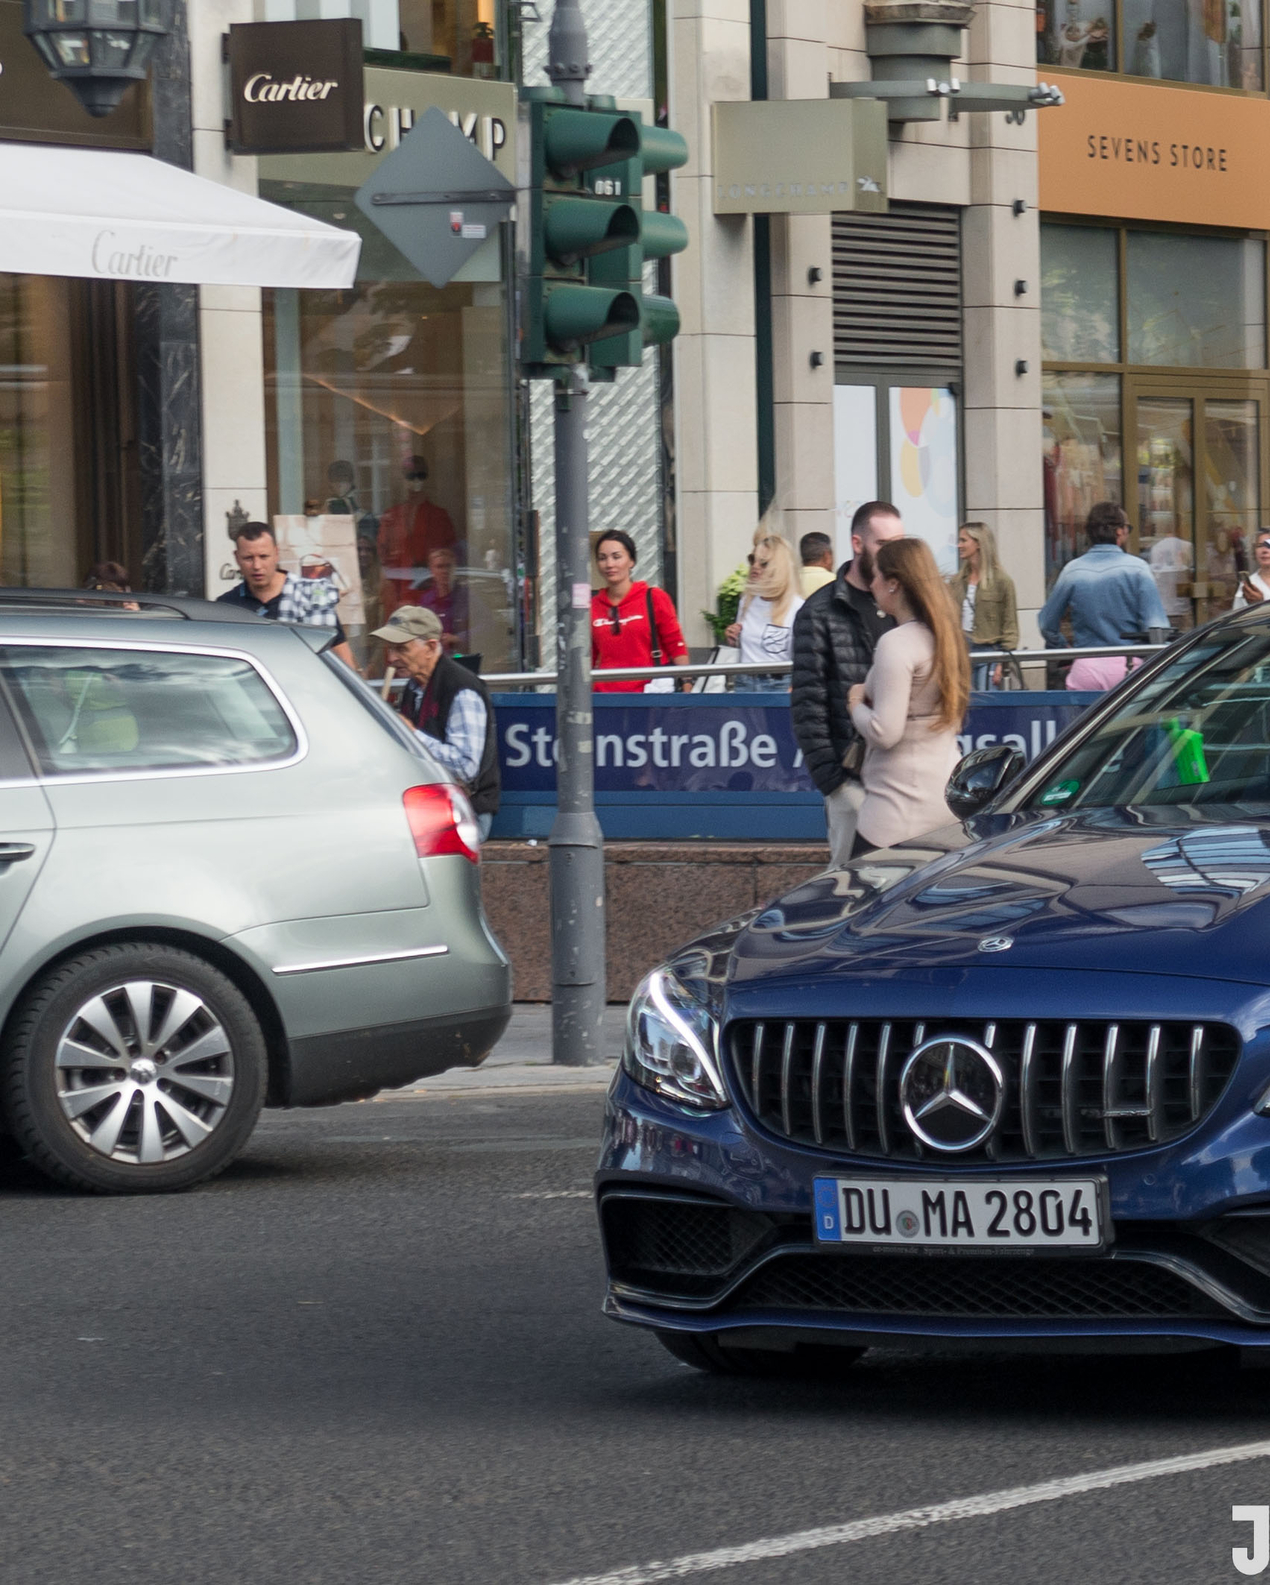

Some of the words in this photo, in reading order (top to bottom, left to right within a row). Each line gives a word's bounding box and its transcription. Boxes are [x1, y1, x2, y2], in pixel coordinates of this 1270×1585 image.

[244, 73, 339, 103] Cartier
[363, 103, 506, 162] CHMP
[1087, 134, 1161, 166] SEVENS
[1169, 142, 1228, 173] STORE
[717, 181, 849, 199] LONGCHAMP
[91, 229, 179, 278] Cartier
[504, 720, 779, 768] Stnstraße
[824, 1215, 835, 1230] D
[842, 1187, 893, 1236] DU
[920, 1189, 976, 1239] MA
[984, 1189, 1093, 1238] 2804
